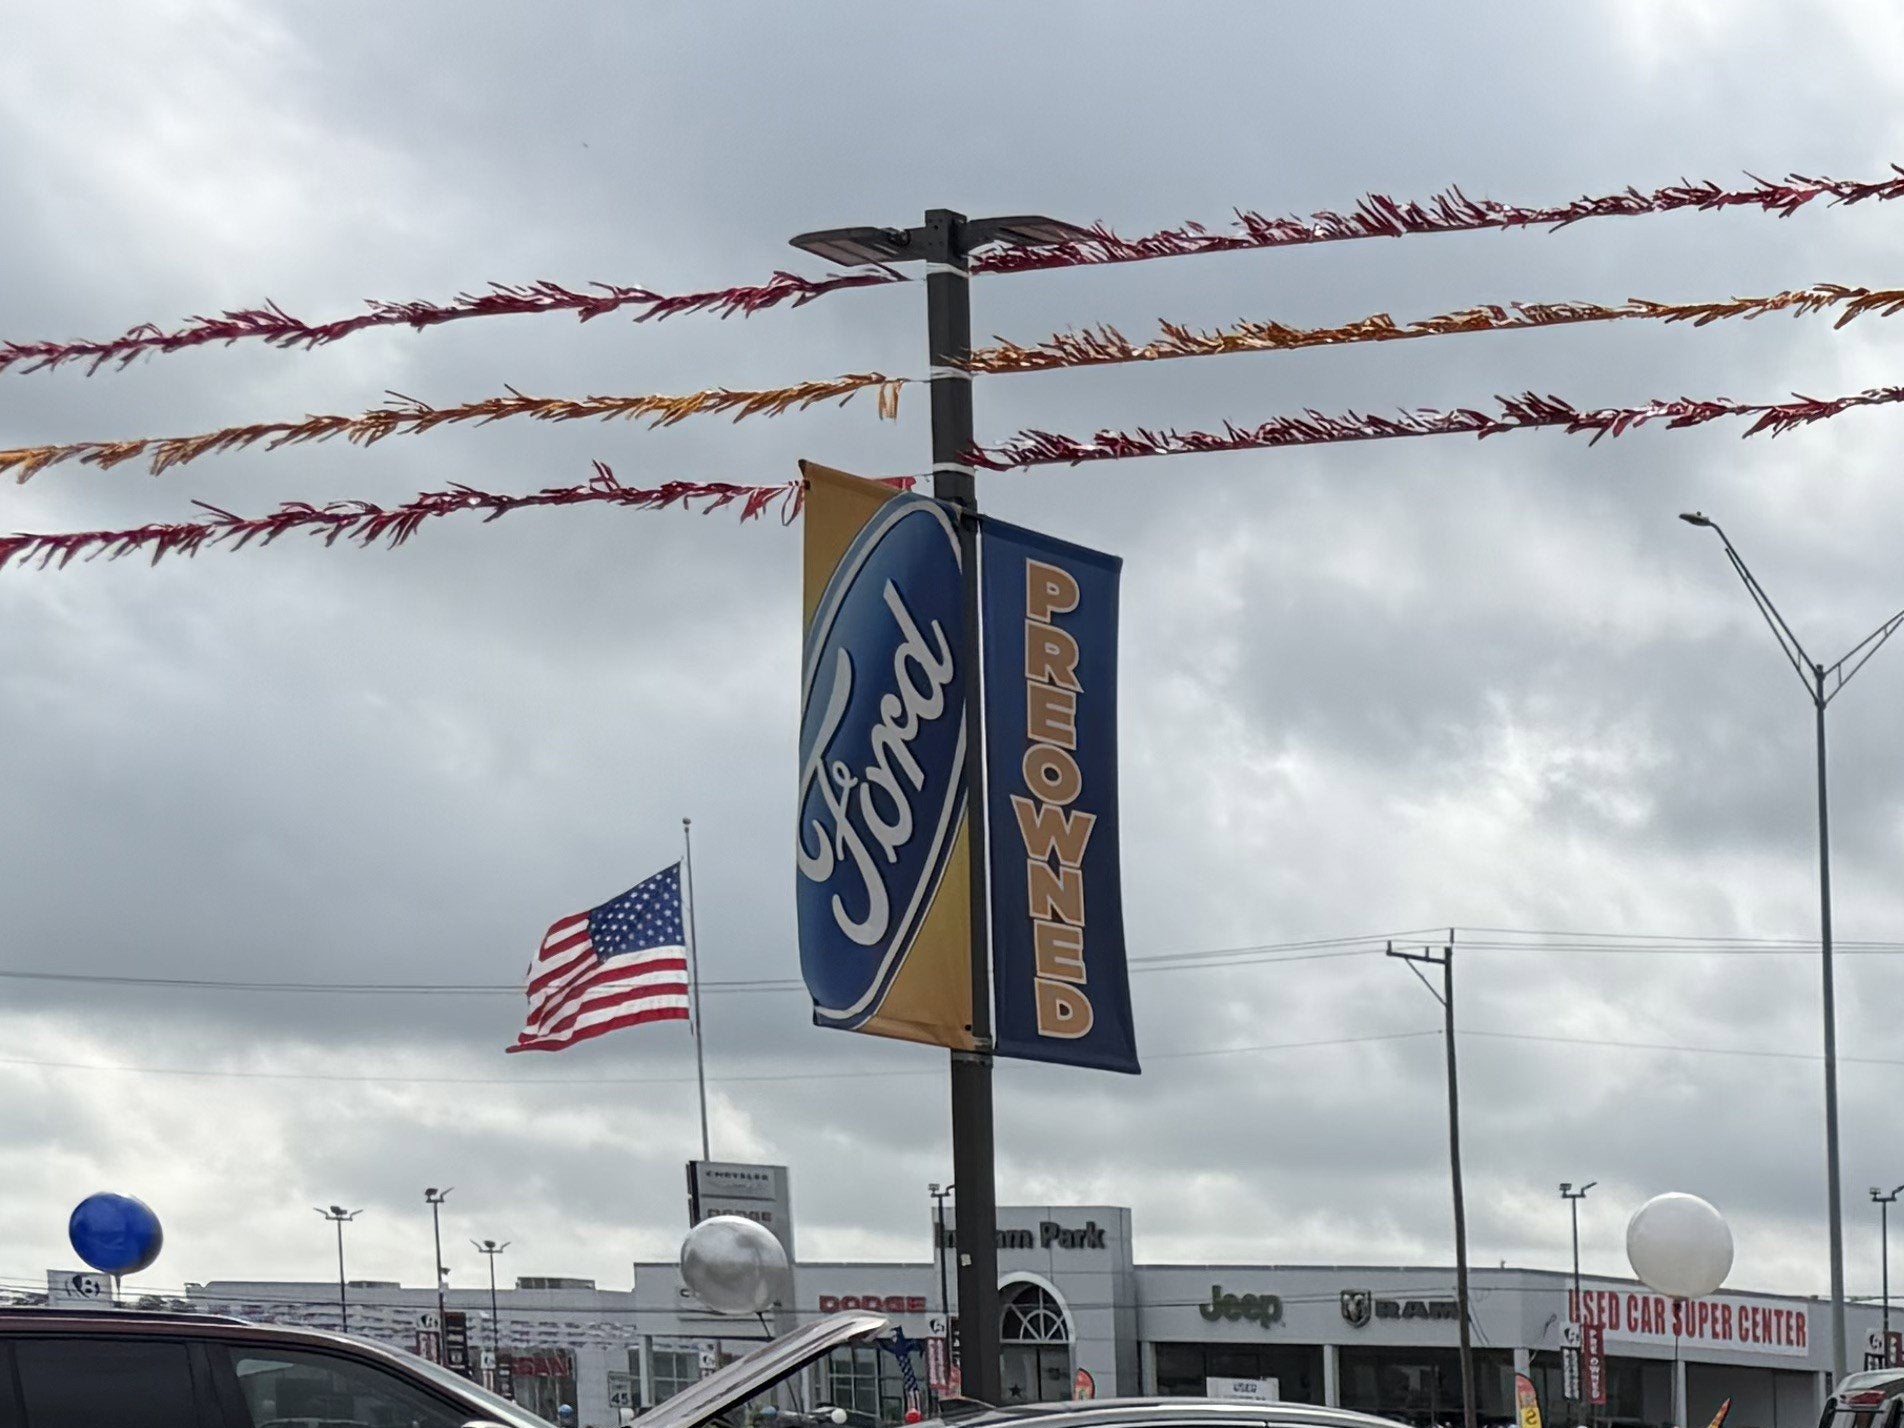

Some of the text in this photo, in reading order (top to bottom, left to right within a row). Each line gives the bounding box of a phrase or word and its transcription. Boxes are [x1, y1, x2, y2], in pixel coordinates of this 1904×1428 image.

[798, 578, 957, 946] Ford
[1009, 556, 1097, 1041] PREOWNED
[1039, 1221, 1106, 1250] Park
[819, 1295, 926, 1314] DODGE
[1199, 1284, 1283, 1329] Jeep
[1374, 1300, 1461, 1320] RAM
[1568, 1289, 1807, 1348] USED CAR SUPER CENTER
